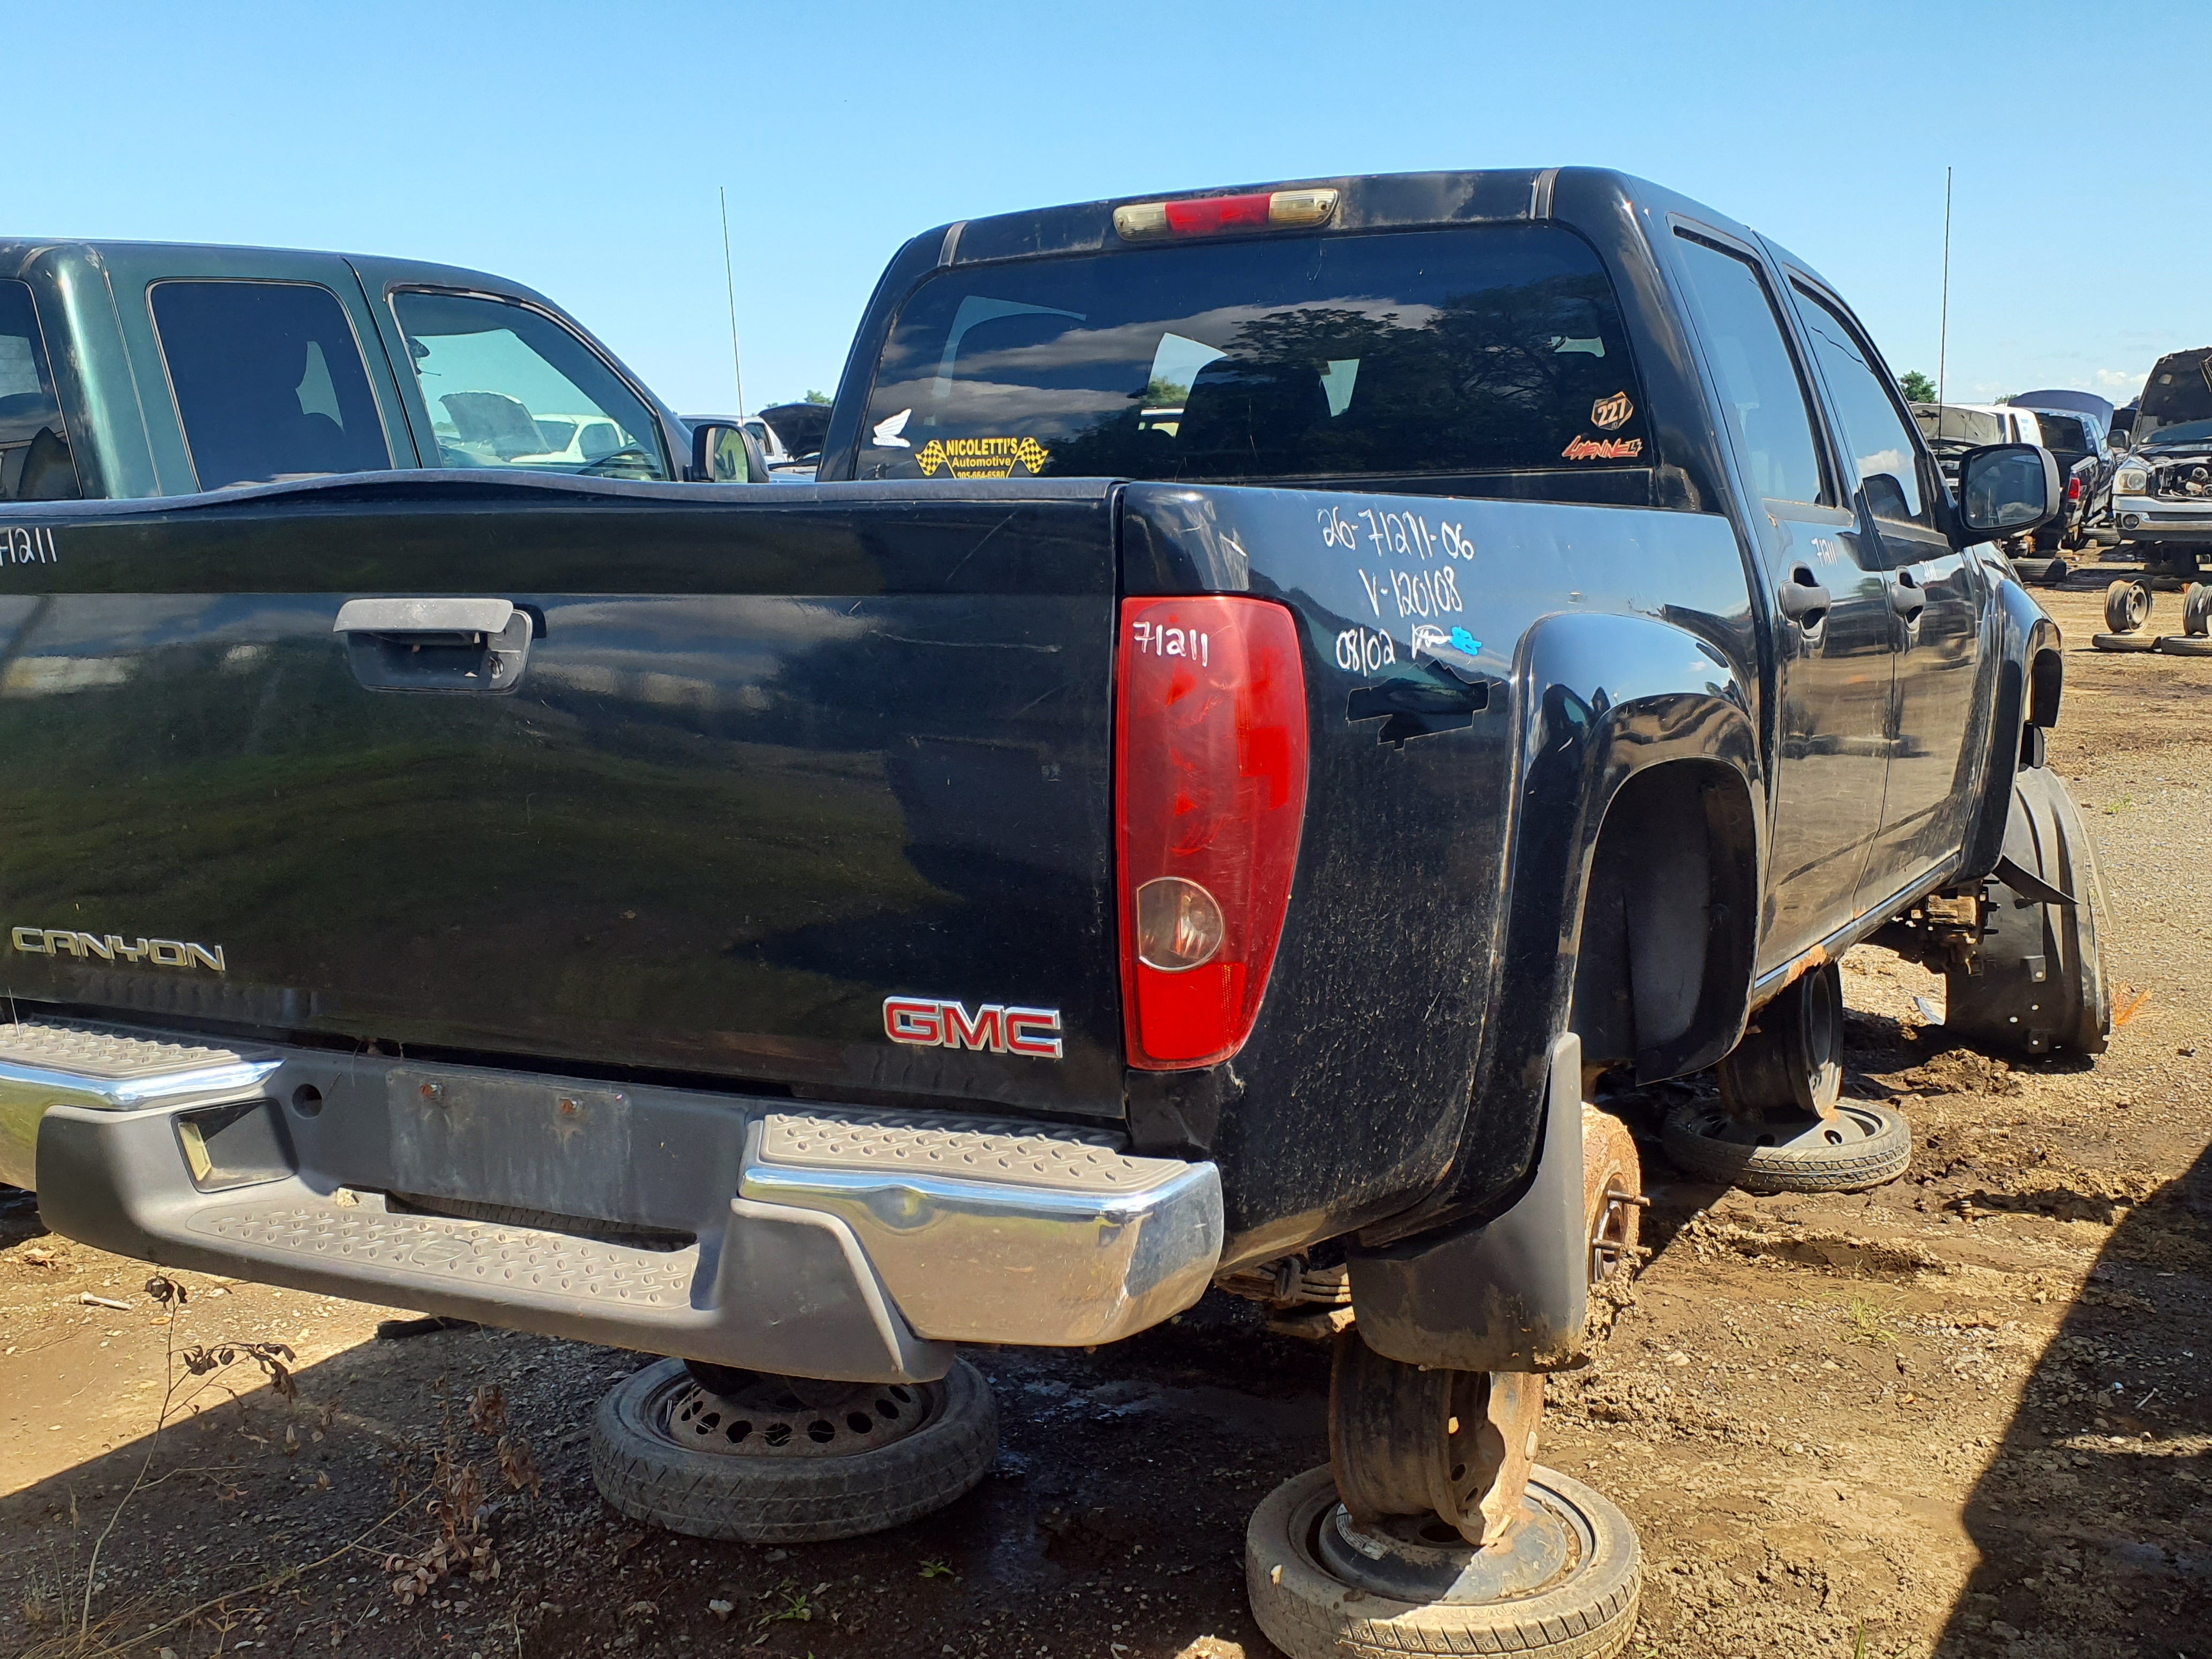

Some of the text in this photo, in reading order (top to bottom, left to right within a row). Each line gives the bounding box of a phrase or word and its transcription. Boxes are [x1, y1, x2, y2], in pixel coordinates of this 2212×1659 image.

[1597, 398, 1626, 427] 227
[946, 437, 1018, 456] NICOLETTI'S
[952, 454, 1011, 468] Automotive
[1133, 621, 1208, 667] 71211
[12, 926, 226, 971] CANYON
[882, 996, 1063, 1059] GMC
